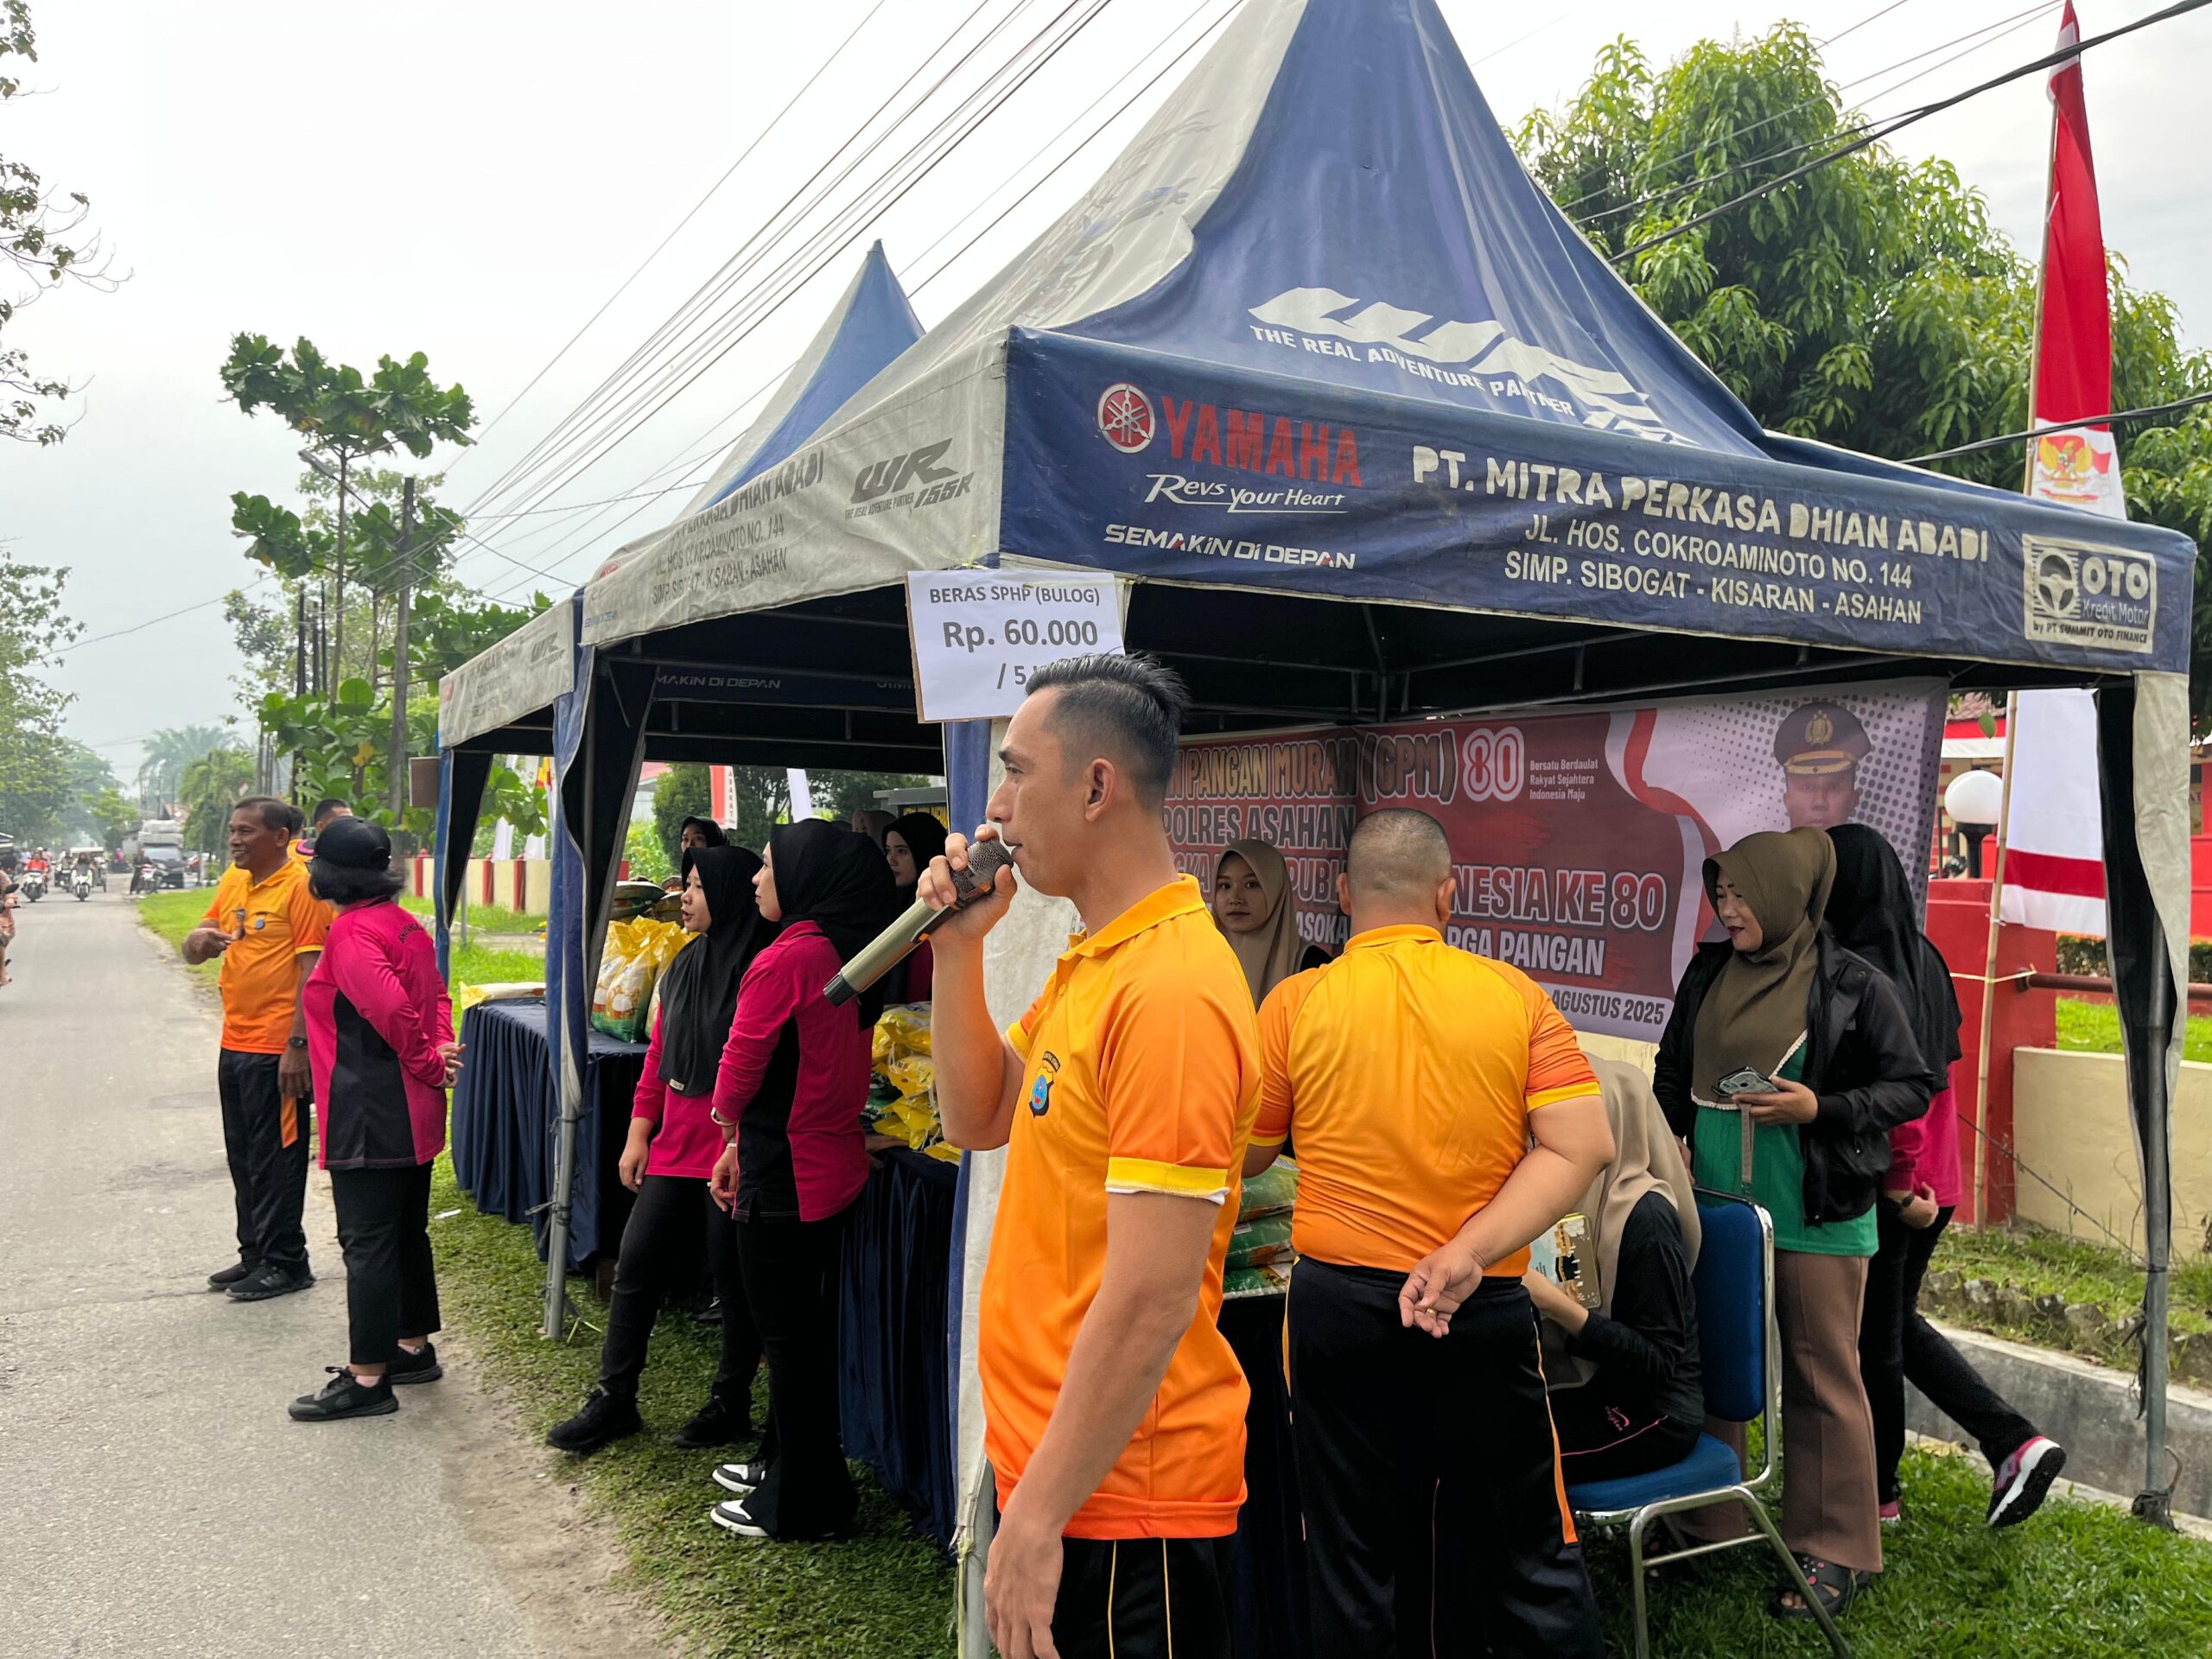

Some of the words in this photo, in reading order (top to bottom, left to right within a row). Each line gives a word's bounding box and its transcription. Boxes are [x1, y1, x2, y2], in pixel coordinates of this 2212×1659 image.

[1250, 325, 1297, 349] THE
[1302, 337, 1361, 362] REAL
[1369, 347, 1485, 391] ADVENTURE
[1162, 396, 1363, 486] YAMAHA
[850, 437, 959, 505] WR
[913, 471, 976, 509] 155R
[1144, 474, 1227, 505] Revs
[1284, 489, 1347, 506] Heart
[1413, 445, 1474, 491] PT.
[1486, 457, 1613, 509] MITRA
[1620, 476, 1781, 535] PERKASA
[1789, 503, 1889, 550] DHIAN
[1897, 519, 1988, 562] ABADI
[768, 512, 785, 540] 144
[750, 547, 787, 580] ASAHAN
[1264, 544, 1356, 569] DEPAN
[1525, 514, 1558, 543] JL.
[1567, 518, 1625, 553] HOS.
[1633, 529, 1826, 580] COKROAMINOTO
[1832, 557, 1873, 584] NO.
[1879, 563, 1912, 589] 144
[1504, 550, 1571, 585] SIMP.
[1580, 561, 1691, 599] SIBOGAT
[1711, 577, 1815, 614] KISARAN
[1834, 591, 1922, 625] ASAHAN
[2082, 556, 2149, 600] OTO
[930, 586, 987, 603] BERAS
[990, 586, 1031, 602] SPHP
[1036, 587, 1100, 607] (BULOG)
[2082, 598, 2117, 621] Kredit
[2119, 602, 2149, 625] Motor
[943, 621, 995, 652] Rp.
[1004, 619, 1098, 646] 60.000
[2033, 622, 2044, 634] by
[2046, 623, 2057, 633] PT
[2060, 624, 2095, 637] SUMMIT
[2097, 628, 2114, 639] OTO
[2117, 630, 2148, 644] FINANCE
[727, 677, 780, 689] DEPAN
[1014, 666, 1027, 685] 5
[1185, 749, 1270, 801] PANGAN
[1272, 737, 1360, 799] MURAH
[1361, 729, 1458, 804] (GPM)
[1463, 726, 1525, 802] 80
[1530, 760, 1559, 771] Bersatu
[1560, 759, 1599, 770] Berdaulat
[1530, 774, 1555, 787] Rakyat
[1557, 773, 1594, 787] Sejahtera
[1530, 788, 1566, 800] Indonesia
[1567, 788, 1585, 802] Maju
[1245, 804, 1355, 850] ASAHAN
[1555, 869, 1605, 926] KE
[1611, 872, 1666, 931] 80
[1499, 929, 1605, 976] PANGAN
[1552, 988, 1622, 1020] AGUSTUS
[1622, 999, 1666, 1026] 2025
